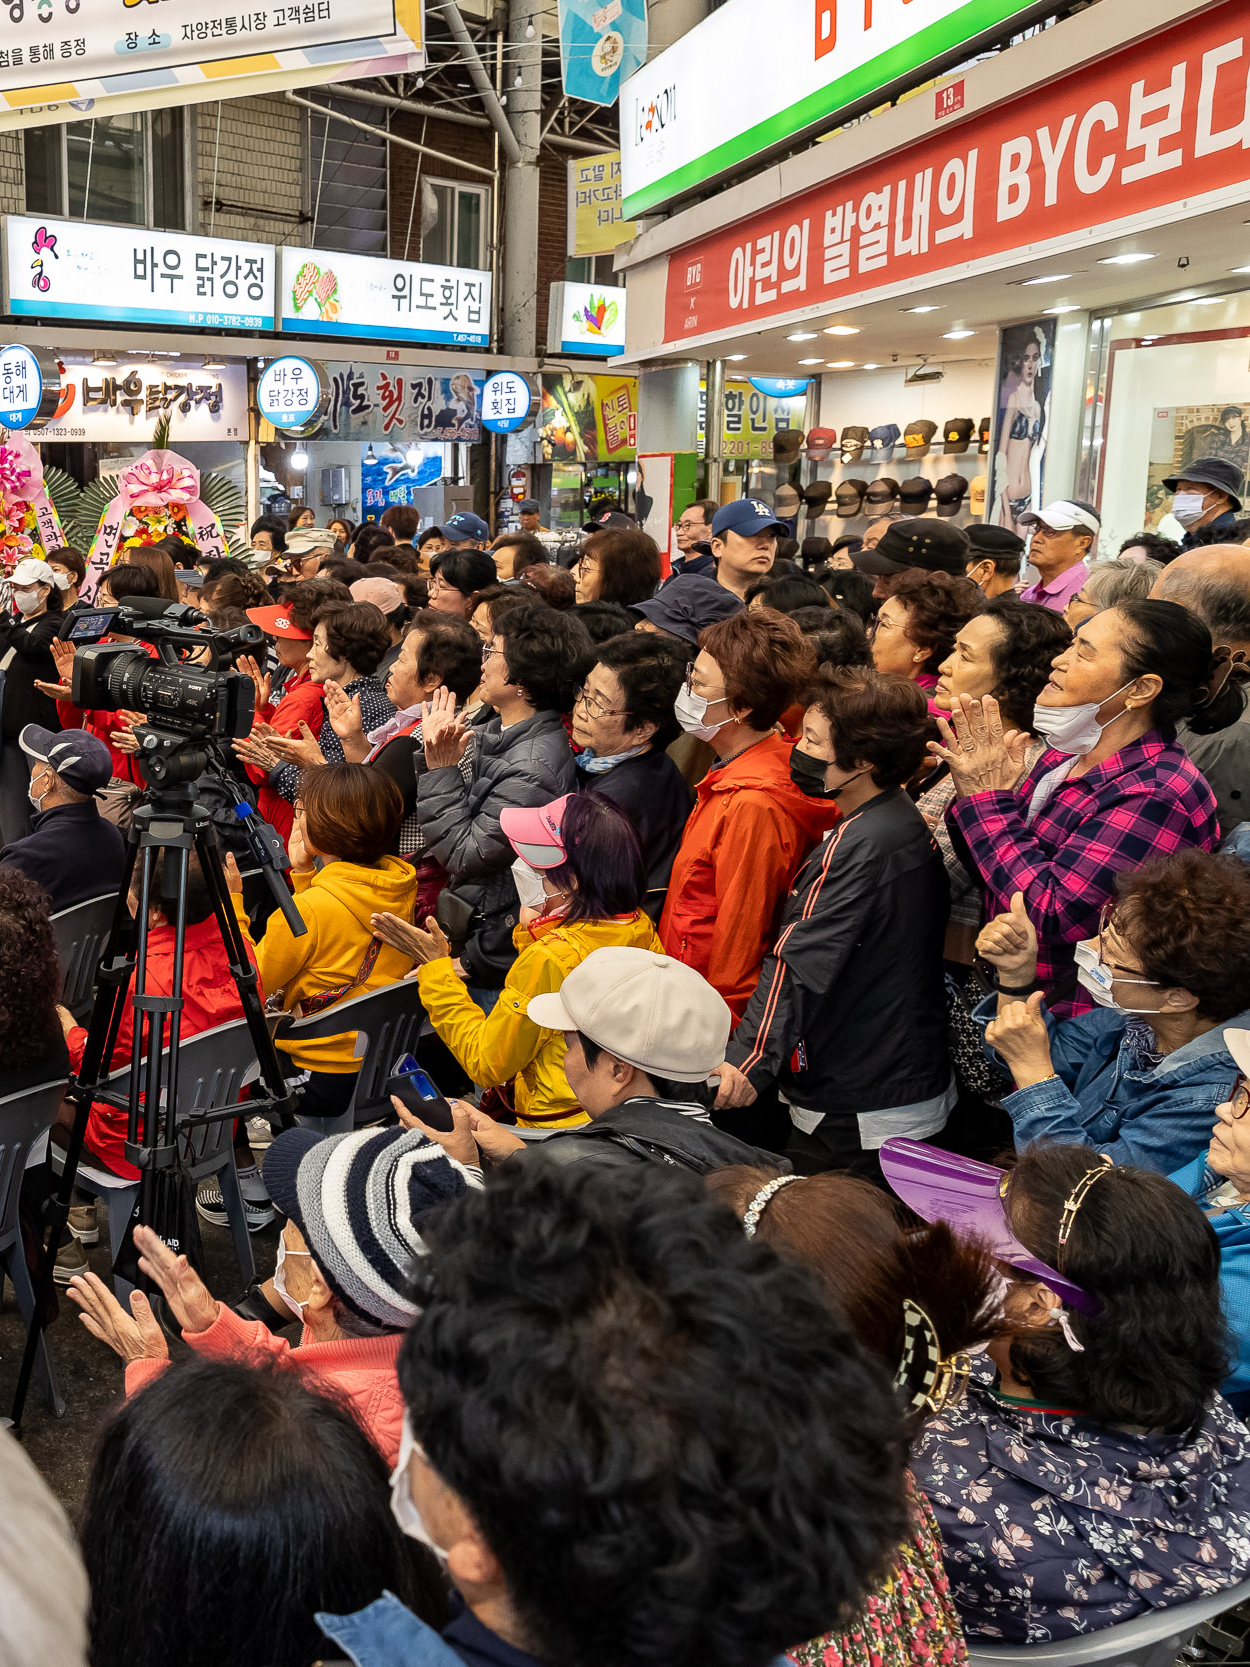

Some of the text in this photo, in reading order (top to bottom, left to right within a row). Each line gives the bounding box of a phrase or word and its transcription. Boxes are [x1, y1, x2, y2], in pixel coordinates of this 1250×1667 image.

[181, 0, 331, 42] 자양전통시장 고객쉼터
[28, 44, 56, 63] 통해
[59, 38, 87, 59] 증정
[942, 87, 954, 109] 13
[728, 217, 810, 310] 아린의
[822, 147, 979, 283] 발열내의
[133, 245, 266, 301] 바우 닭강정
[686, 263, 702, 286] BYC
[391, 273, 482, 323] 위도횟집
[189, 313, 263, 328] H.P 010-3782-0939
[1, 359, 28, 386] 동해
[274, 366, 304, 386] 바우
[2, 384, 29, 404] 대게
[268, 386, 310, 407] 닭강정
[491, 379, 517, 397] 위도
[9, 411, 23, 423] 대게
[490, 397, 517, 416] 횟집
[750, 501, 771, 517] LA
